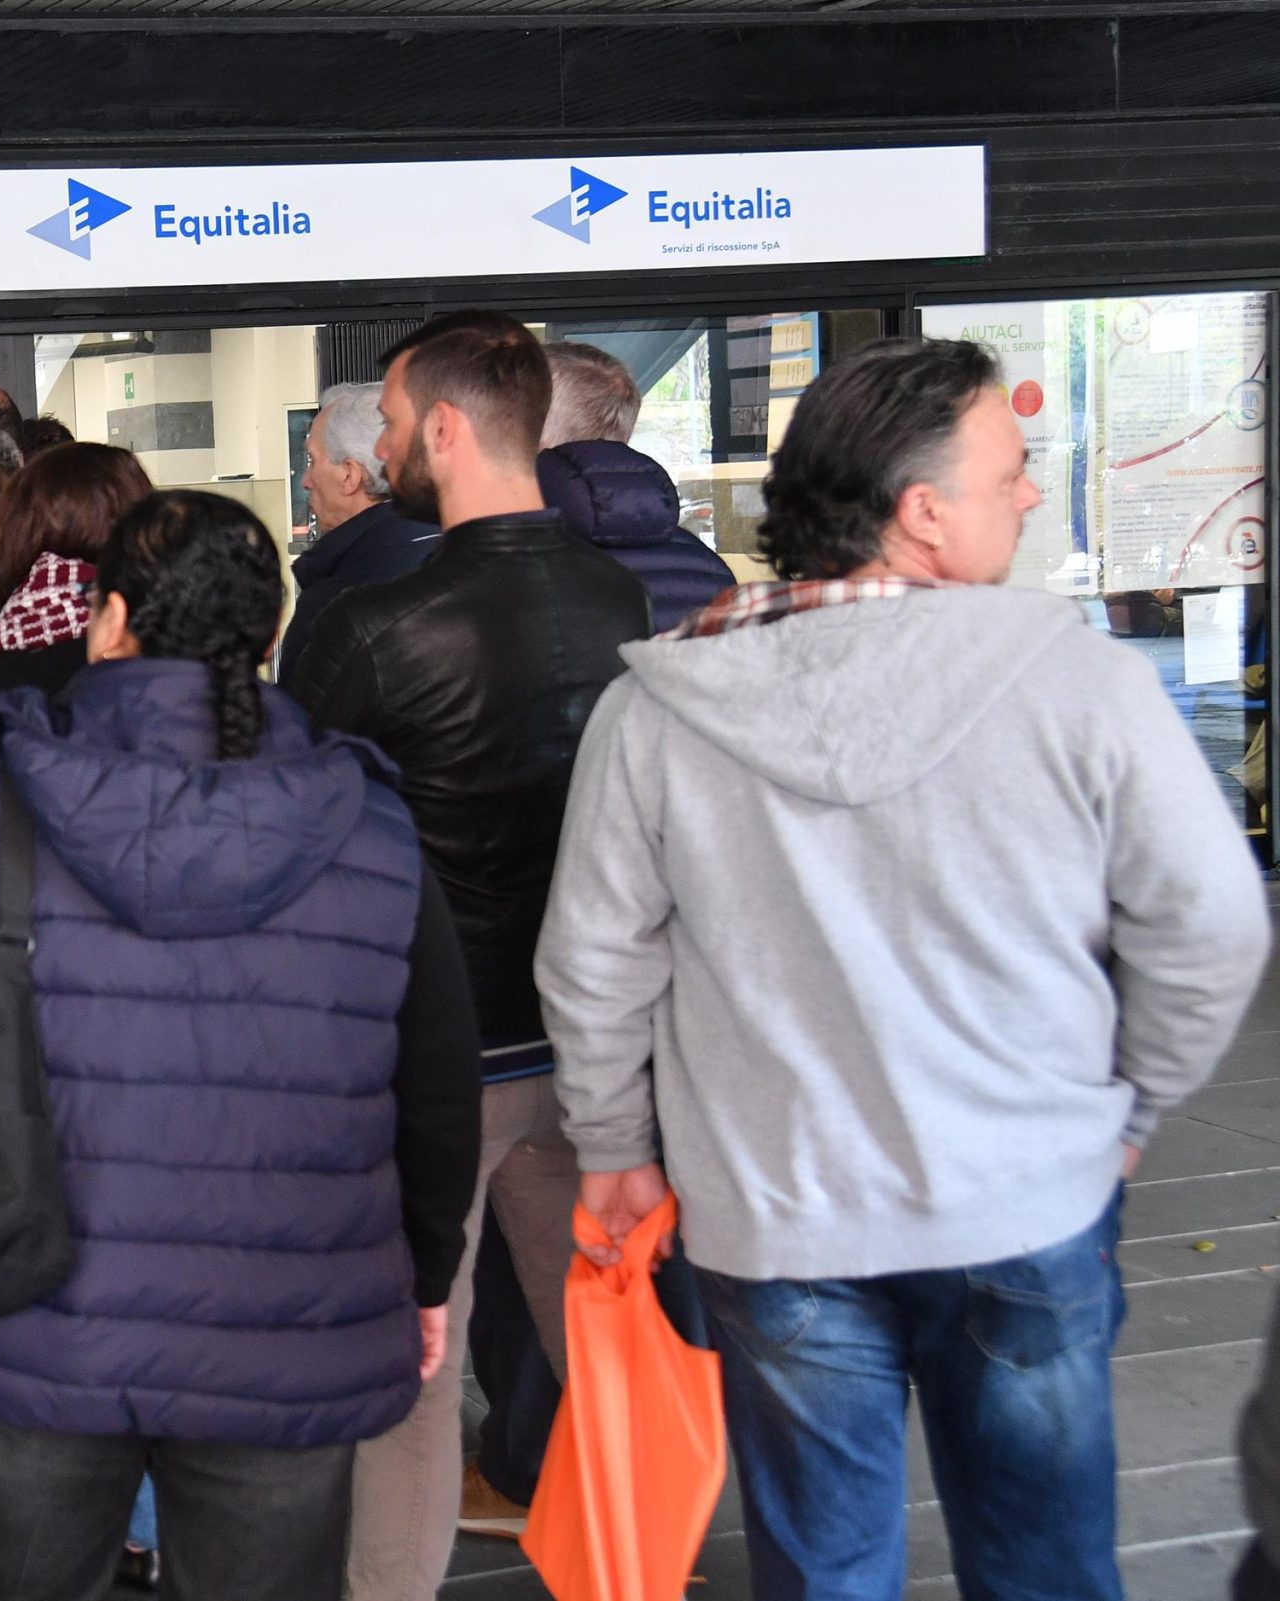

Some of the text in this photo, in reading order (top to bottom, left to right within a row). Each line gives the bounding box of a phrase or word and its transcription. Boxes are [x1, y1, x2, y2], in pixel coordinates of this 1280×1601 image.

[154, 201, 311, 245] Equitalia
[648, 187, 791, 229] Equitalia
[662, 240, 780, 254] Servizi di riscossione SpA
[960, 323, 1023, 341] AIUTACI
